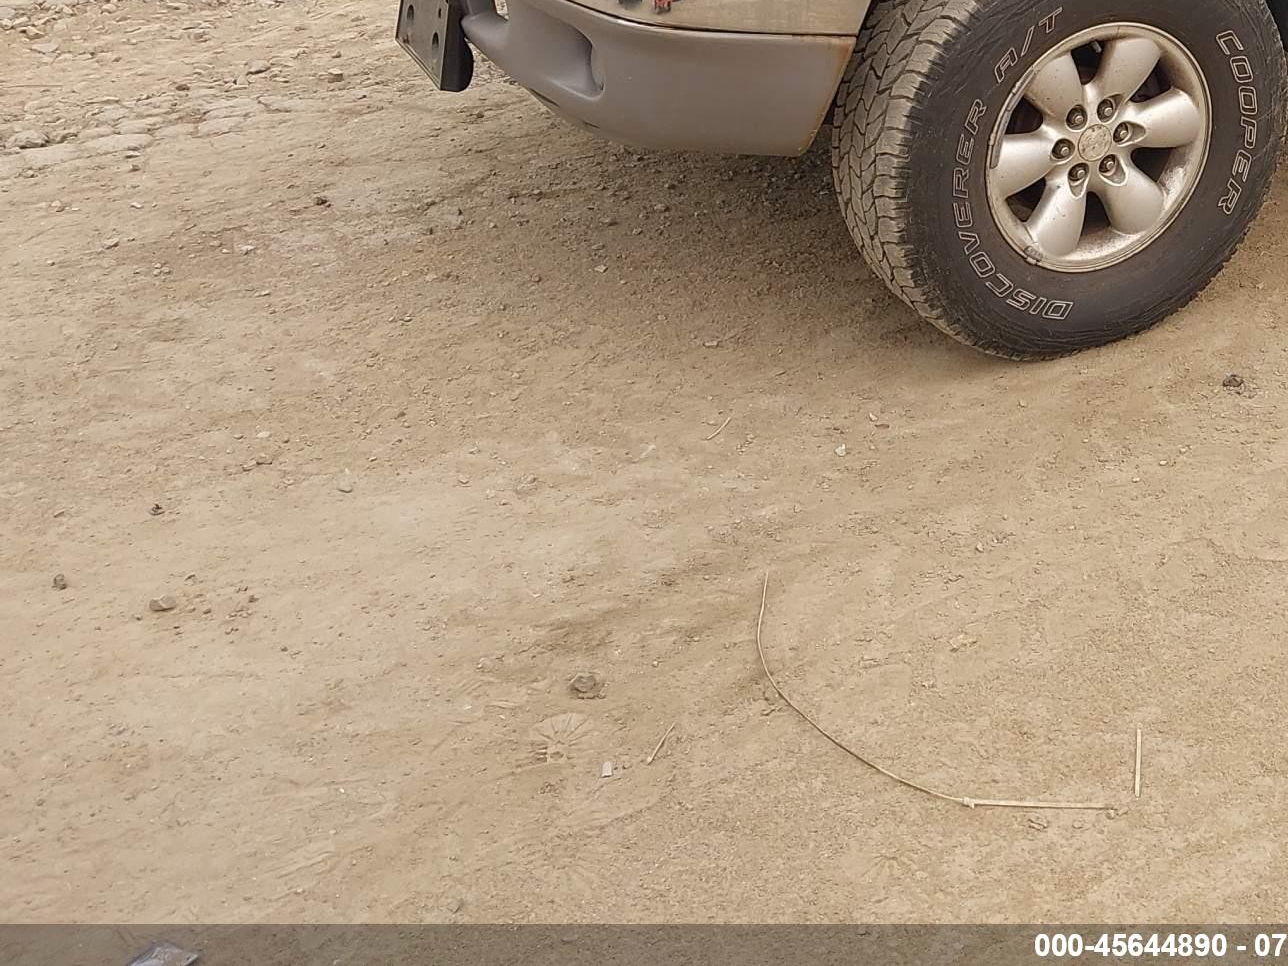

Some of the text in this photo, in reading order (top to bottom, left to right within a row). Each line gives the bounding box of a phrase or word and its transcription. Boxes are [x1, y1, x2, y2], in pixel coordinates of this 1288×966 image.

[952, 6, 1074, 321] DISCOVERER A/T
[1215, 29, 1259, 216] COOPER
